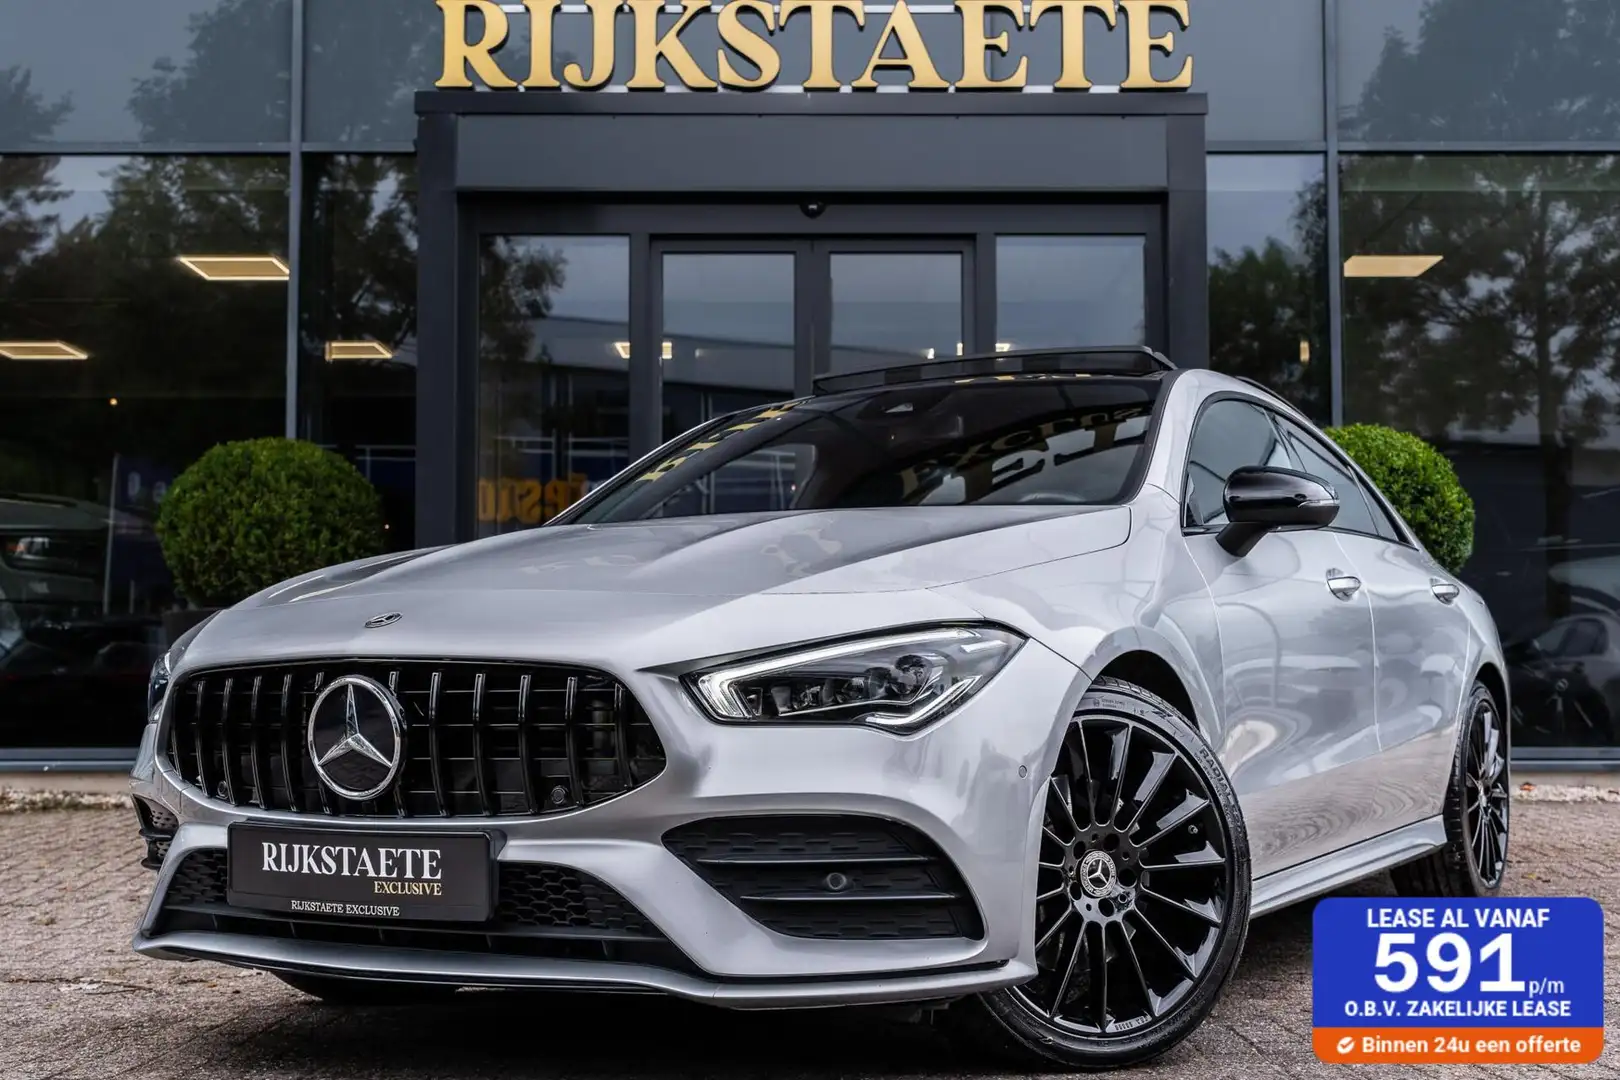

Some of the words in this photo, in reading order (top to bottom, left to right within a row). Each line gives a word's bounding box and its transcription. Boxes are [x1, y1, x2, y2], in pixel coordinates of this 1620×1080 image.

[434, 0, 1193, 90] RIJKSTAETE
[261, 841, 442, 880] RIJKSTAETE
[373, 880, 442, 896] EXCLUSIVE
[290, 900, 344, 914] RIJKSTAETE
[346, 903, 400, 917] EXCLUSIVE
